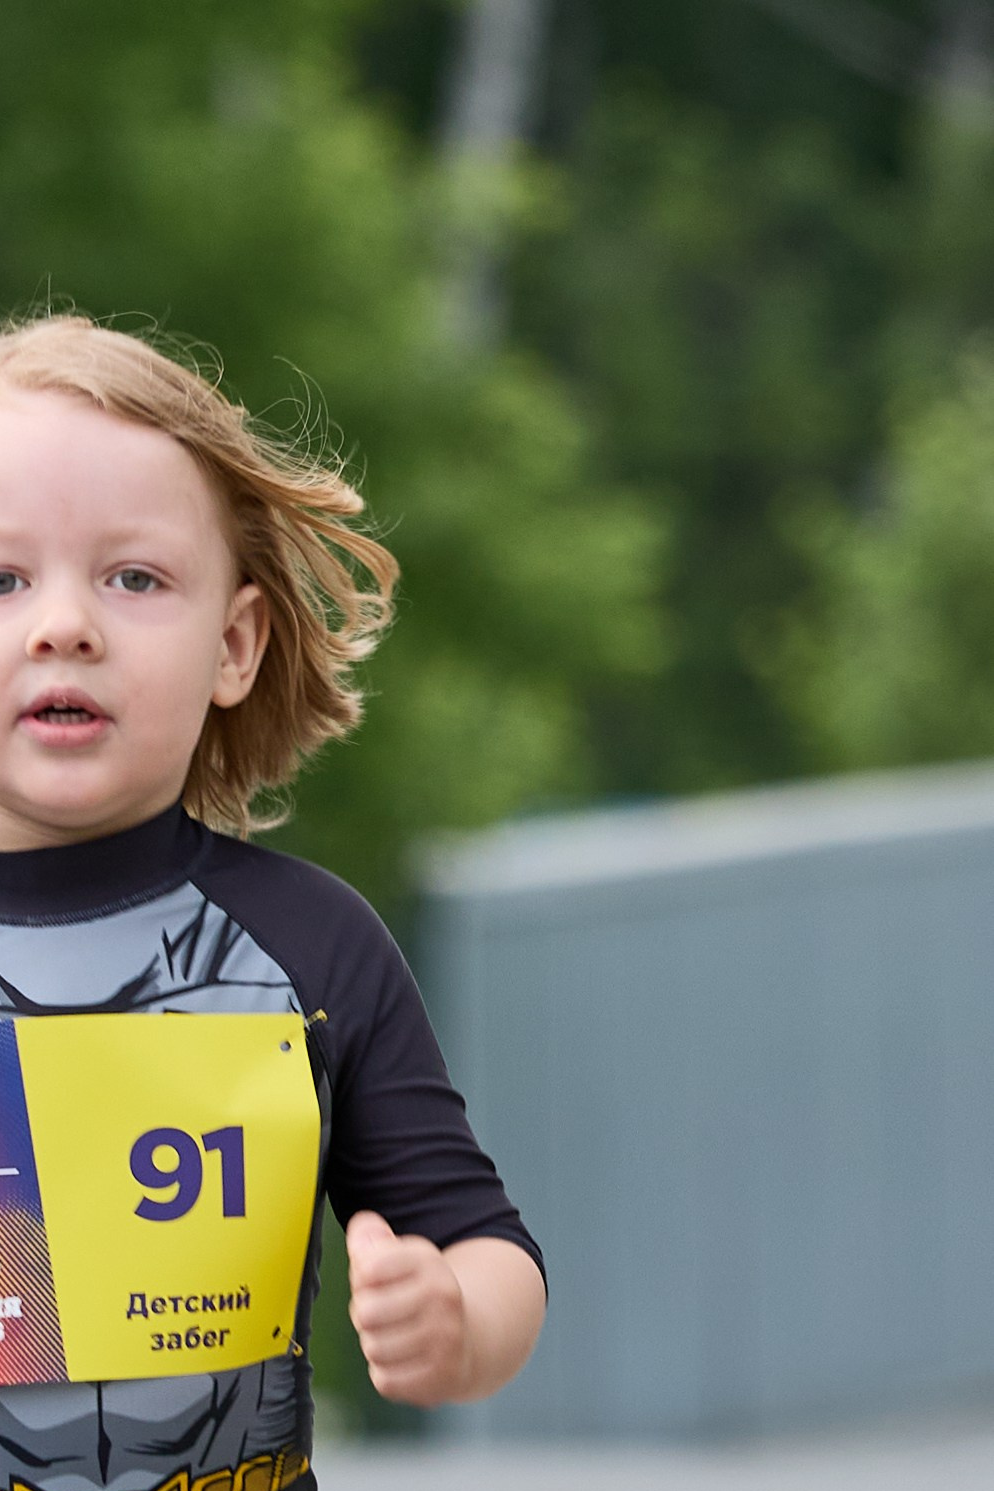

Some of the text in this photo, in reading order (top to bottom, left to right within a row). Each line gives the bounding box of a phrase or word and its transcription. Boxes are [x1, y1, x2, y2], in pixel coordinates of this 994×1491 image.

[129, 1126, 247, 1222] 91
[126, 1285, 251, 1320] Детский
[149, 1325, 231, 1352] забег
